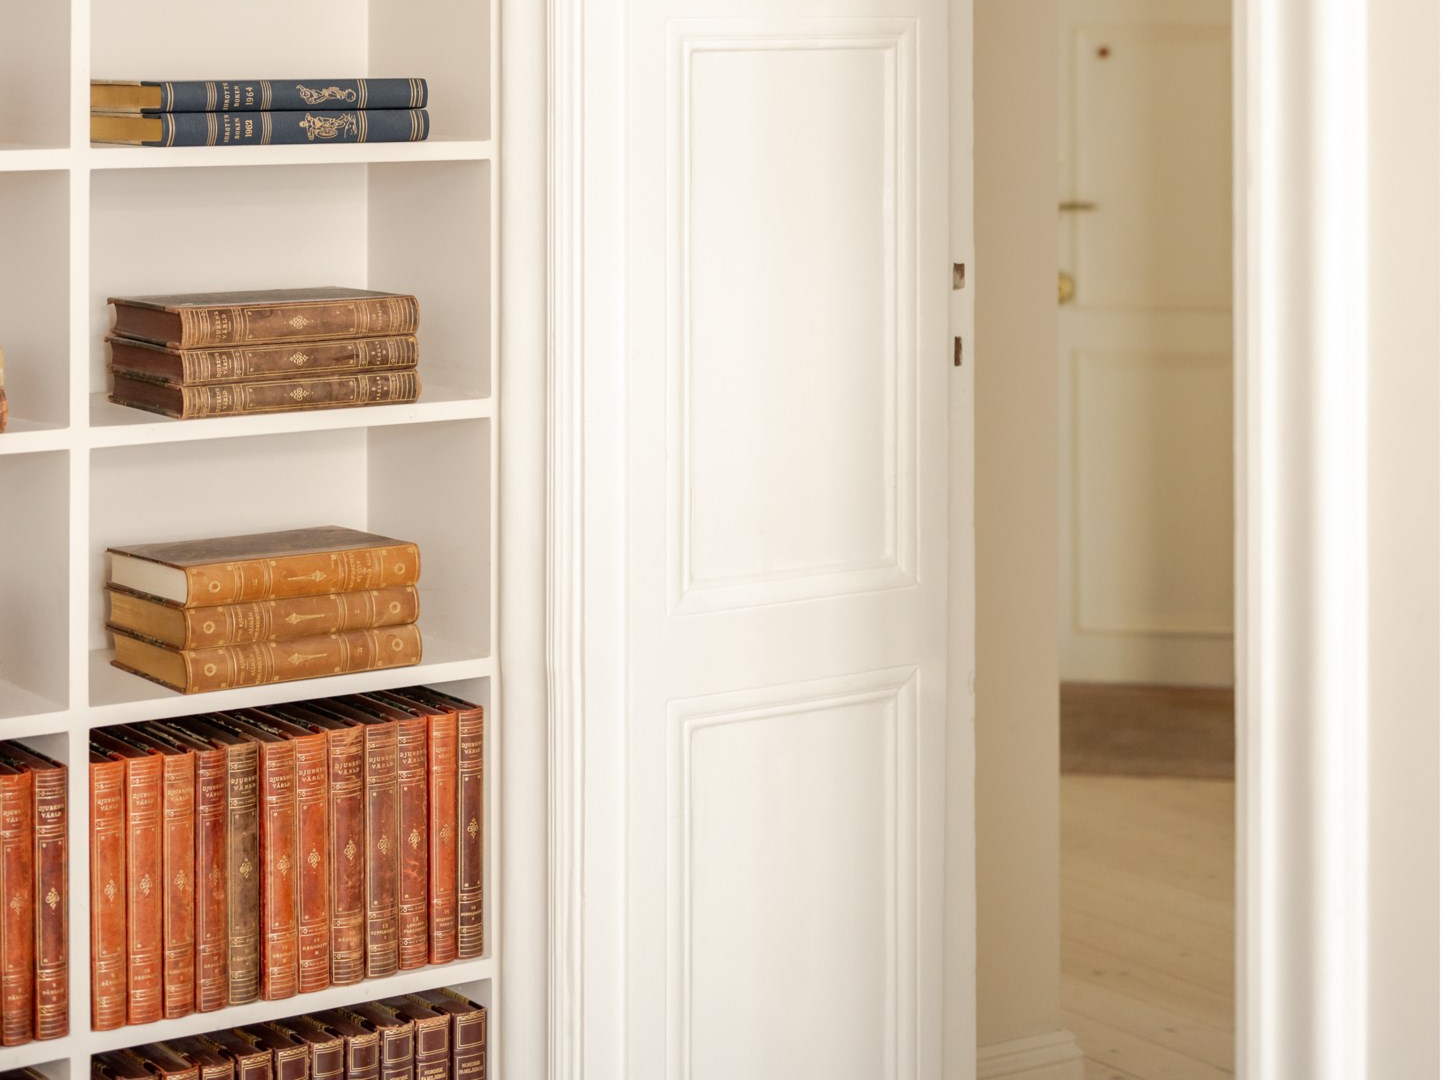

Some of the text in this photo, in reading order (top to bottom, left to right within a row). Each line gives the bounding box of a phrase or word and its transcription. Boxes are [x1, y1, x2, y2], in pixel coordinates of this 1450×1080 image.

[245, 87, 254, 105] 1964
[223, 114, 231, 143] IDROTTS
[245, 119, 253, 137] 1962
